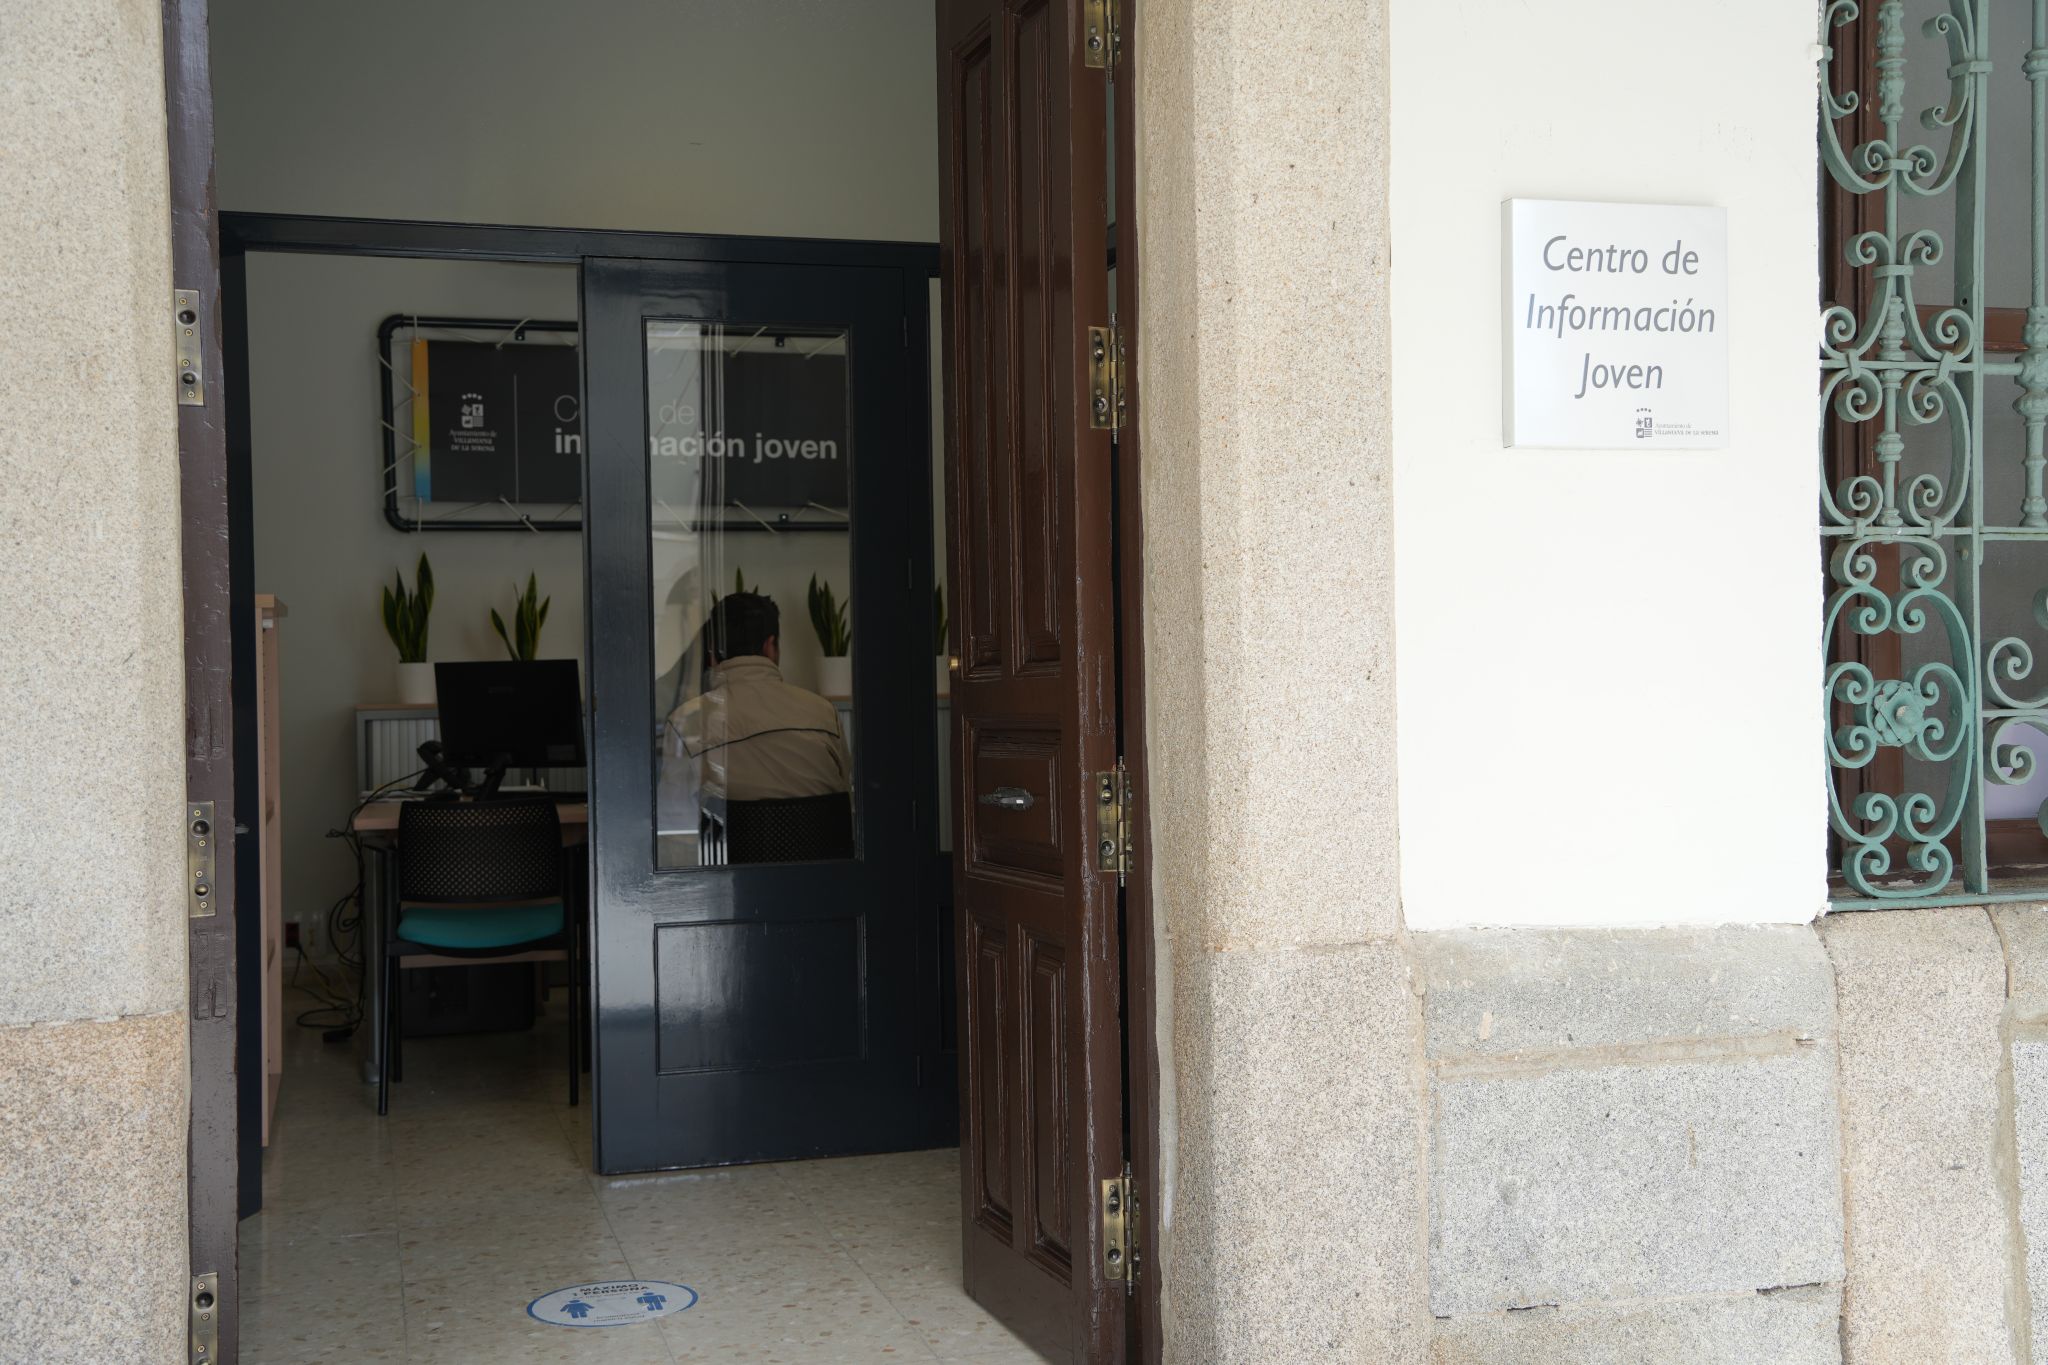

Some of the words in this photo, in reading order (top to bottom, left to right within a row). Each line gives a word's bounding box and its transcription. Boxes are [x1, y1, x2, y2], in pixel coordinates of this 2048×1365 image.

[1543, 235, 1648, 274] Centro
[1661, 239, 1699, 275] de
[1526, 293, 1715, 339] Información
[1574, 352, 1664, 399] Joven
[659, 399, 695, 425] de
[555, 427, 745, 458] inación
[753, 432, 837, 464] joven
[584, 1286, 650, 1296] PERSONA
